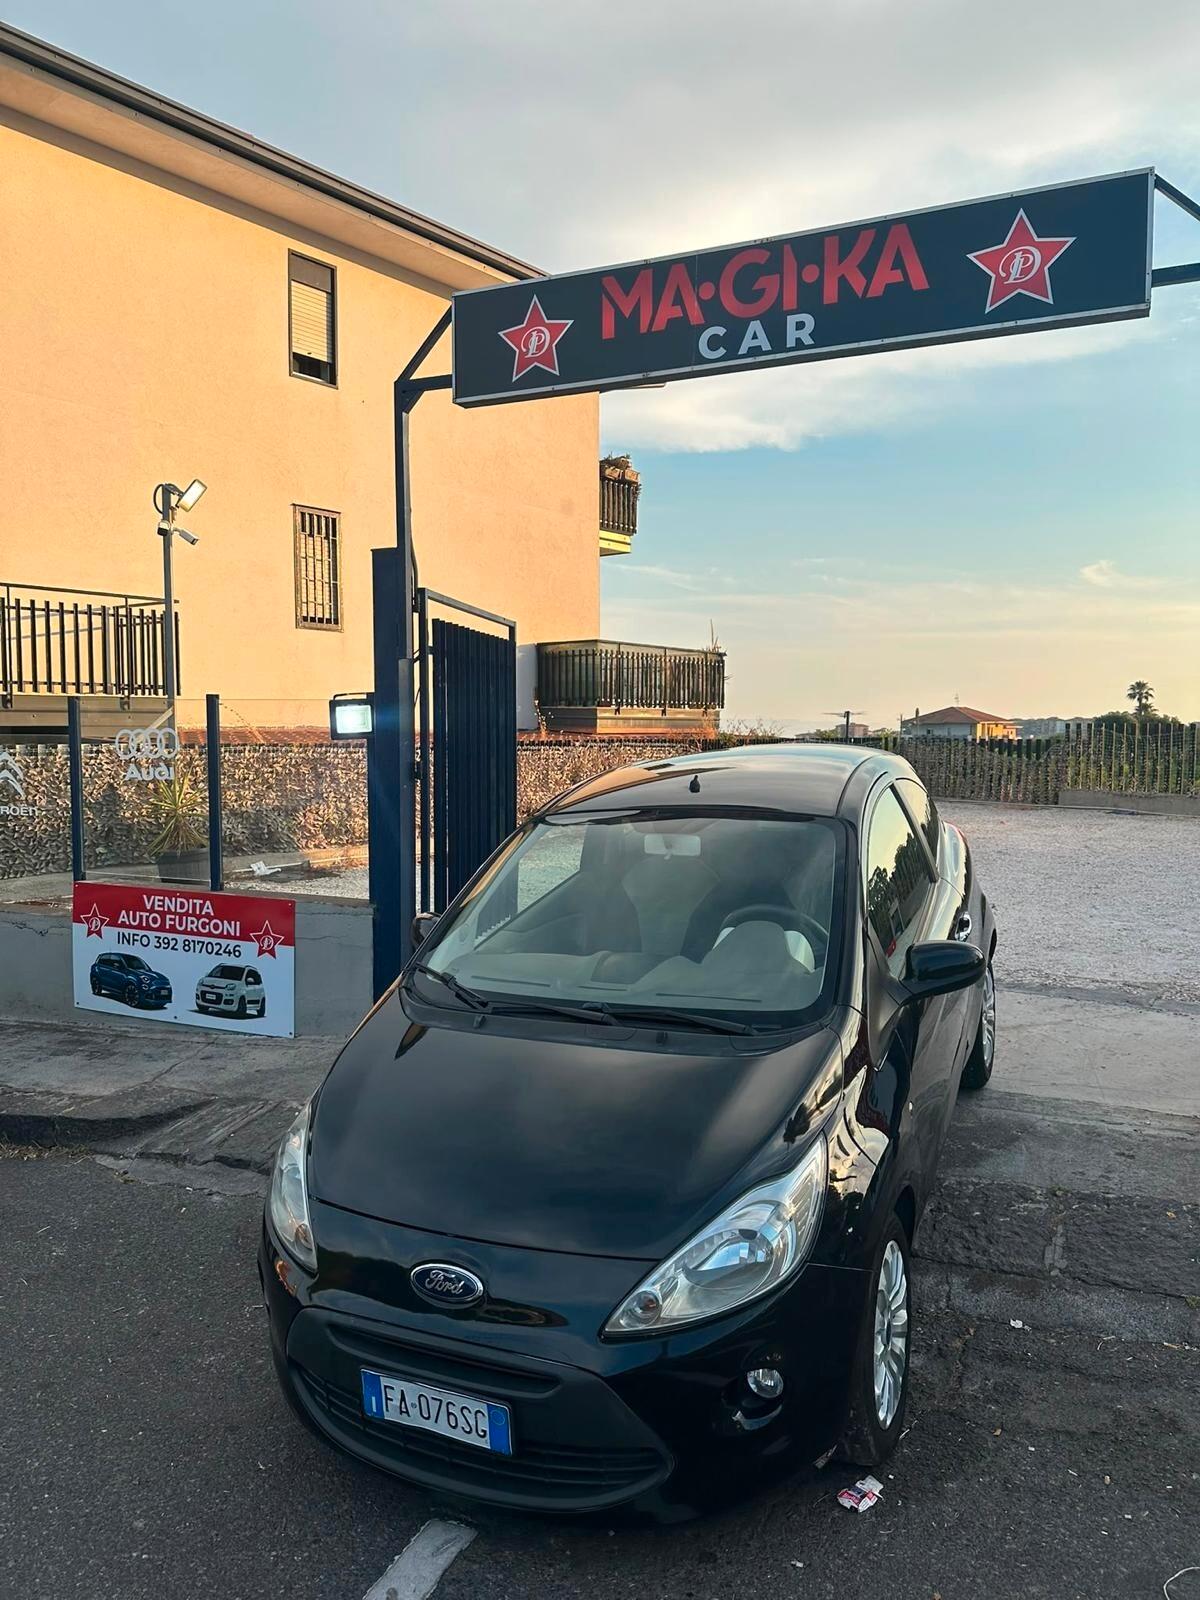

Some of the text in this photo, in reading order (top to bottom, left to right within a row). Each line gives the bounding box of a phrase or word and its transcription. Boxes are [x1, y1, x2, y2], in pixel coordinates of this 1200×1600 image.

[698, 312, 816, 360] CAR
[124, 762, 175, 781] Audi
[143, 894, 214, 916] VENDITA
[118, 910, 162, 928] AUTO
[165, 917, 241, 937] FURGONI
[117, 931, 150, 948] INFO
[154, 935, 179, 952] 392
[182, 939, 242, 959] 8170246
[425, 1269, 465, 1295] Ford
